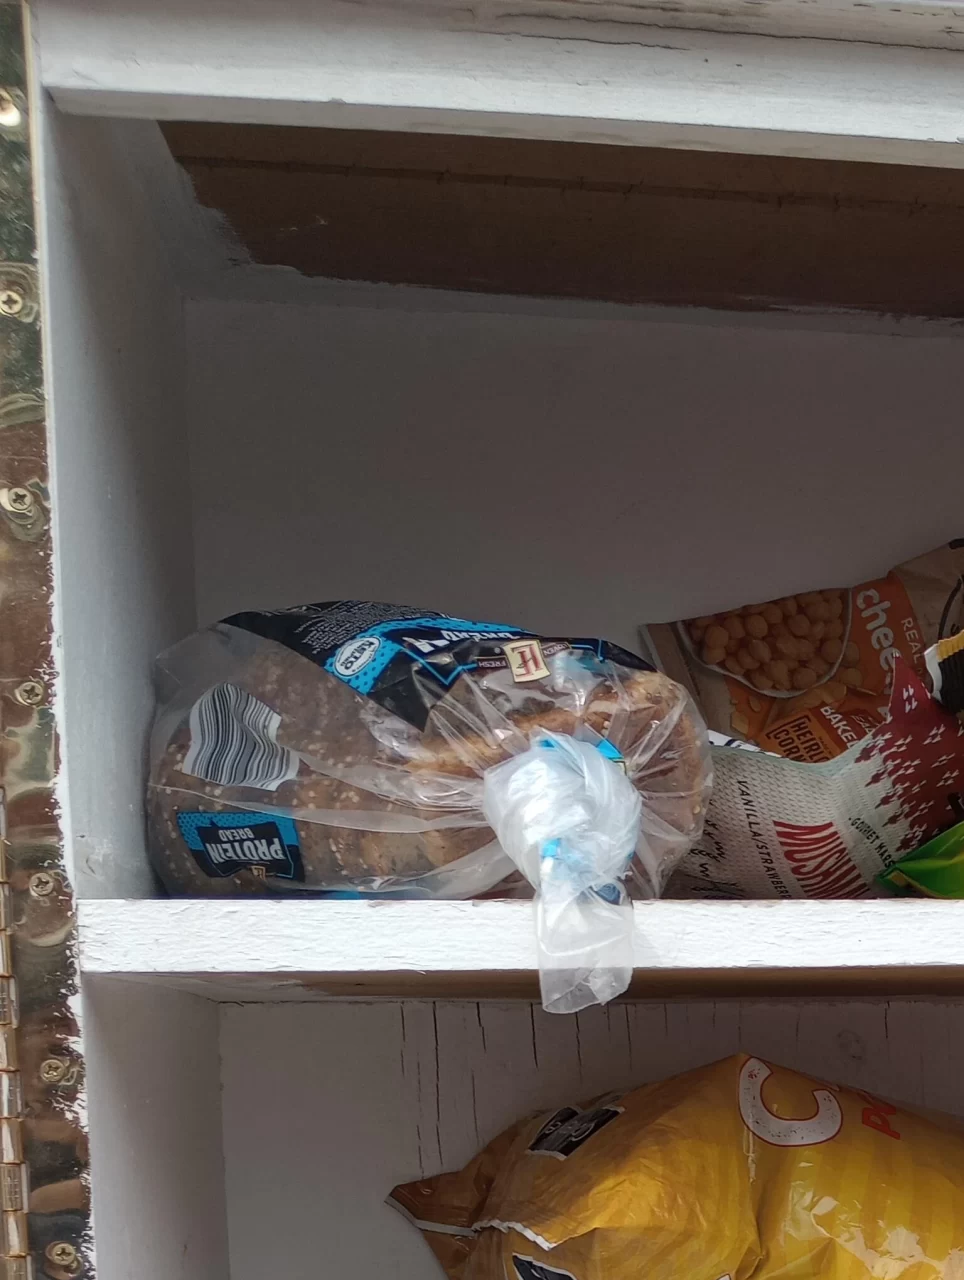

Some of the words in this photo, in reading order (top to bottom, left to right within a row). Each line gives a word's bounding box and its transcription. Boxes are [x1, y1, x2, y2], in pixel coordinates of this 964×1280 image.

[901, 617, 919, 663] REAL
[218, 827, 255, 842] BREAD
[205, 837, 286, 864] PROTEIN
